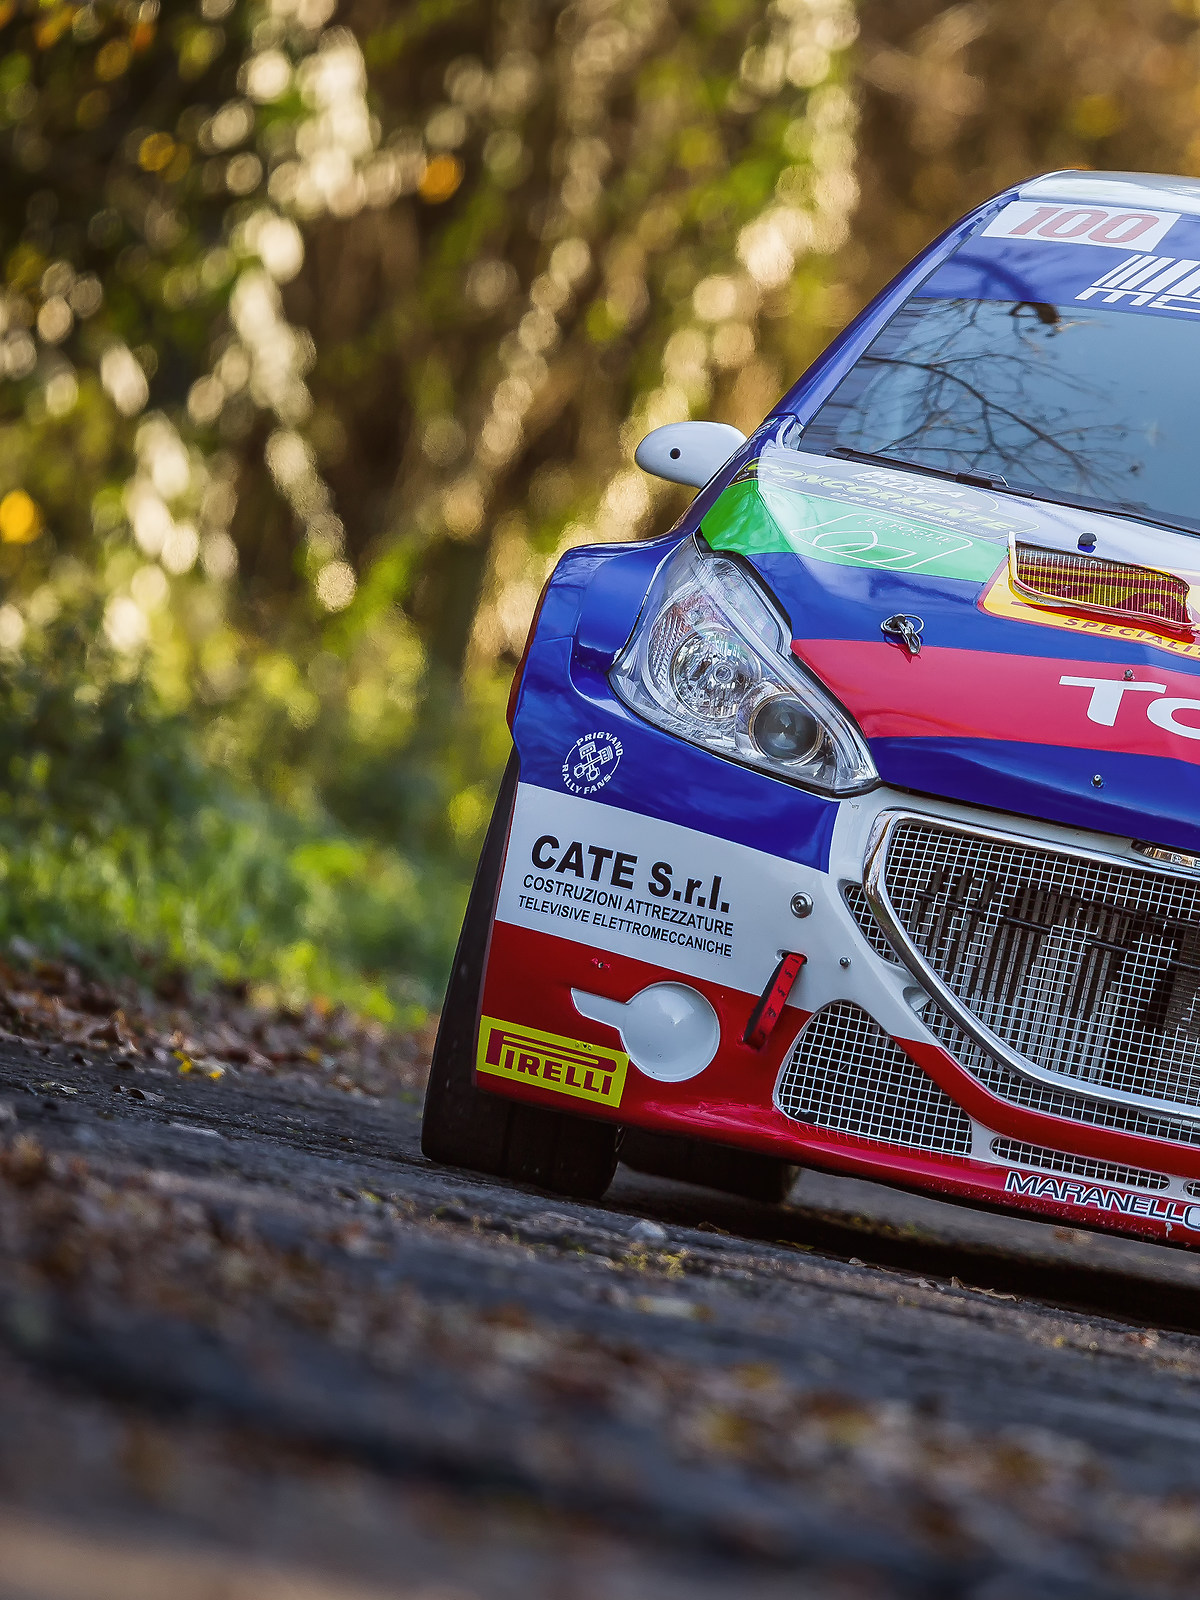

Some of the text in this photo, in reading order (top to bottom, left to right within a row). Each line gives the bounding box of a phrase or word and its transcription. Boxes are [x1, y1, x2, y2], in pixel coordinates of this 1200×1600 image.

[1008, 206, 1160, 244] 100
[561, 763, 612, 795] RALLY FANS
[523, 873, 734, 937] COSTRUZIONI ATTREZZATURE
[531, 834, 731, 914] CATE S.r.l.
[518, 894, 733, 958] TELEVISIVE ELETTROMECCANICHE
[485, 1027, 618, 1096] PIRELLI
